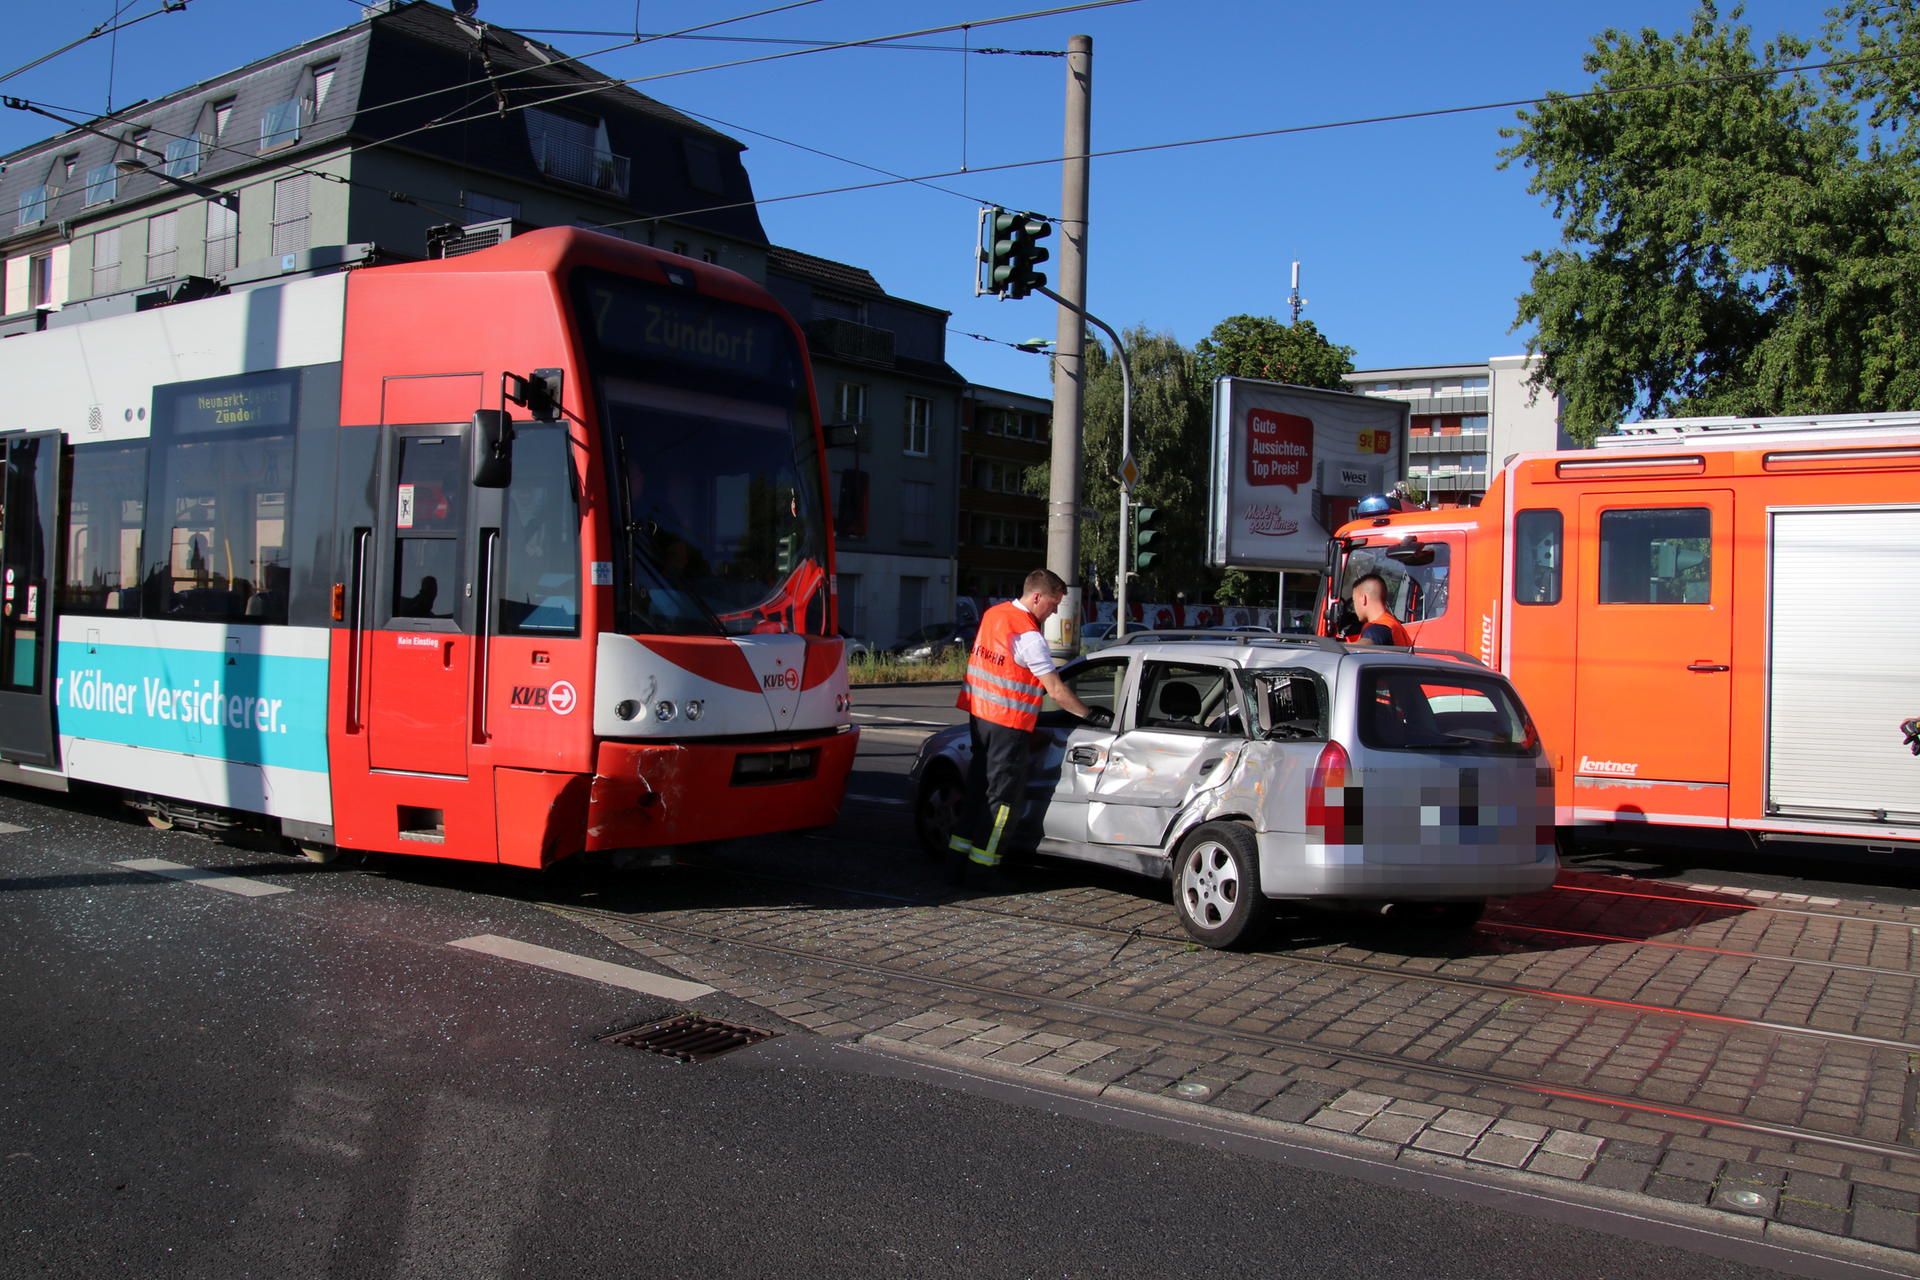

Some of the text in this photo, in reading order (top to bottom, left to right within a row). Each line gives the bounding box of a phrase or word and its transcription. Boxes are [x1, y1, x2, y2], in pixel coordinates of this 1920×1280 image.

[596, 288, 754, 363] 7 Zündorf
[1252, 416, 1277, 434] Gute
[1252, 438, 1309, 457] Aussichten.
[1252, 459, 1300, 479] Top Preis!
[1342, 470, 1368, 484] West
[1480, 614, 1492, 667] ntner
[764, 674, 785, 689] KVB
[56, 668, 287, 734] r Kölner Versicherer.
[511, 686, 548, 706] KVB
[1578, 755, 1639, 776] Lentner
